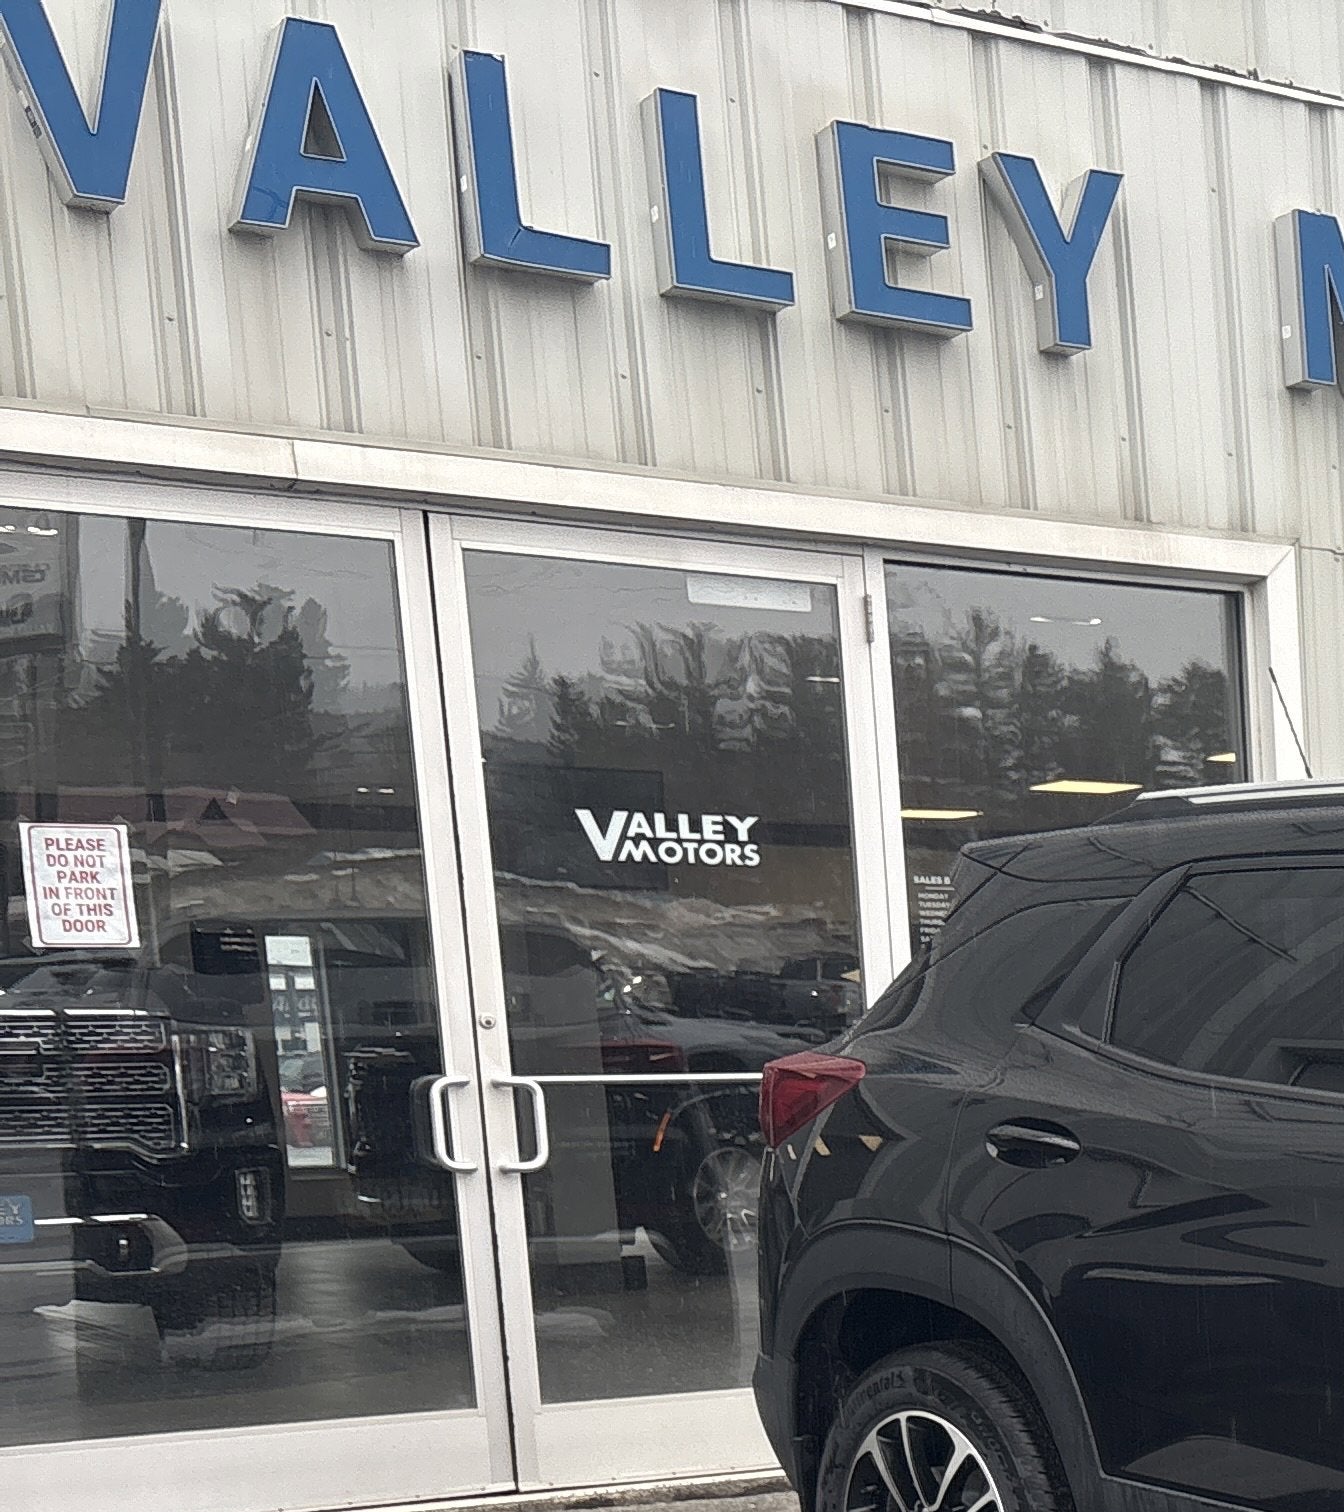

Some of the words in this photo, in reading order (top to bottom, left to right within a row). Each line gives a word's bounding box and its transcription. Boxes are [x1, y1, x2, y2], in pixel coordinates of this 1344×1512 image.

[0, 0, 1124, 355] VALLEY
[574, 808, 760, 861] VALLEY
[44, 838, 106, 851] PLEASE
[617, 839, 761, 867] MOTORS
[46, 854, 69, 868] DO
[73, 855, 106, 868] NOT
[56, 871, 102, 884] PARK
[913, 875, 942, 884] SALES
[42, 886, 60, 899] IN
[64, 887, 118, 900] FRONT
[51, 903, 73, 916] OF
[76, 903, 114, 917] THIS
[62, 919, 107, 932] DOOR
